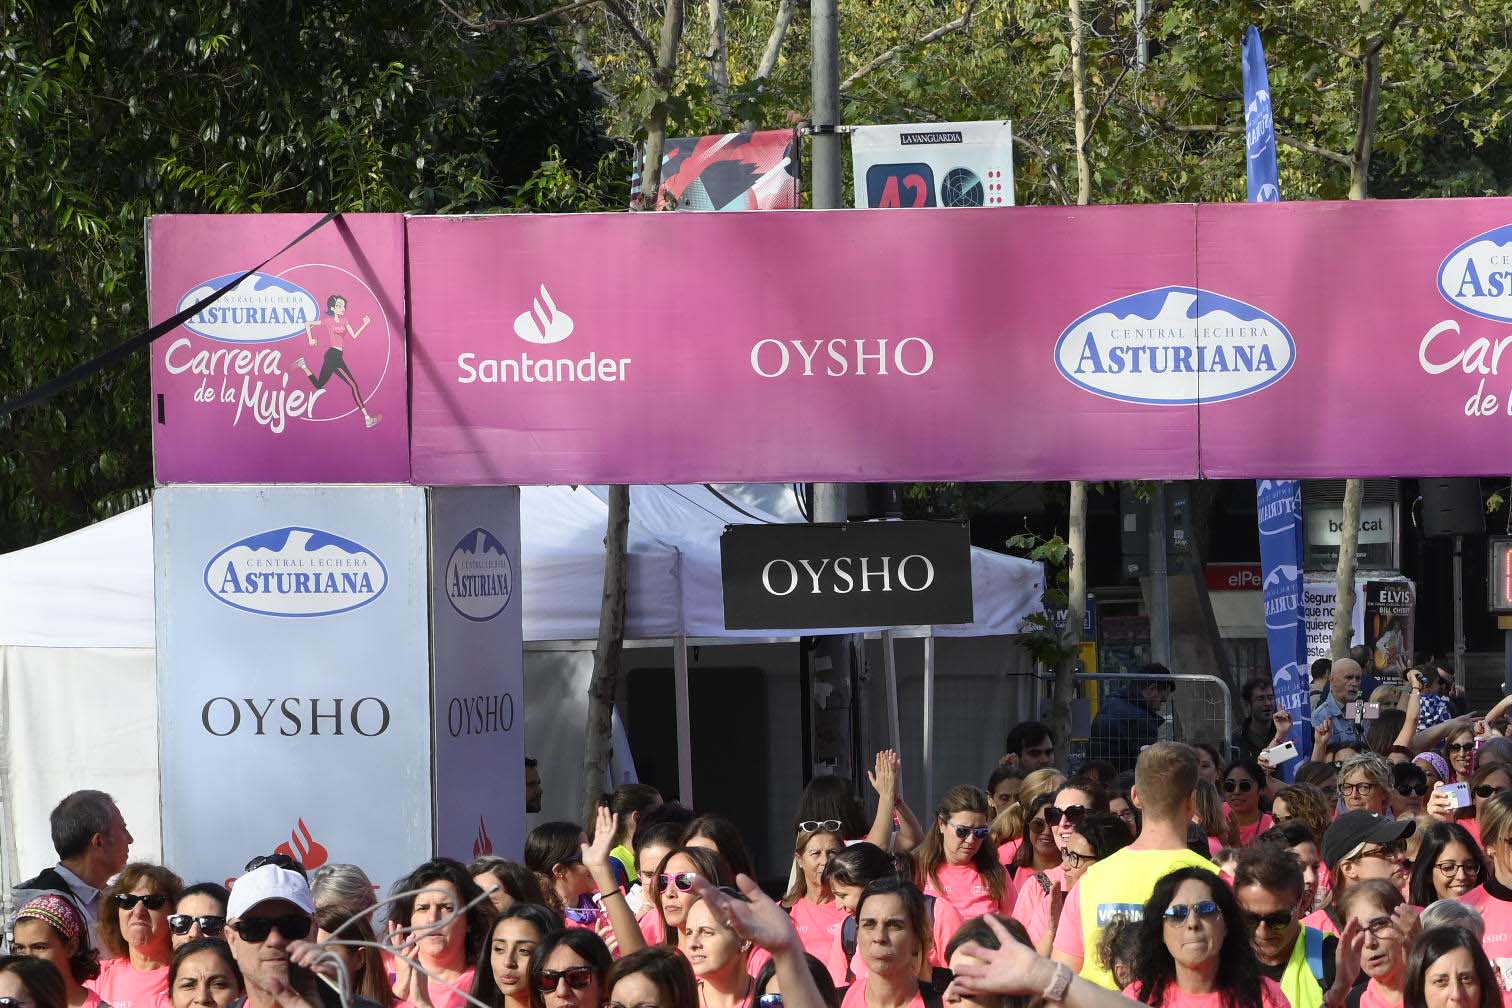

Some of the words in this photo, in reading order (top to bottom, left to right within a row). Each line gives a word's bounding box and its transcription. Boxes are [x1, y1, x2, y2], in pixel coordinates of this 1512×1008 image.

[1111, 328, 1184, 339] CENTRAL
[1193, 327, 1269, 338] LECHERA
[164, 338, 281, 376] Carrera
[457, 352, 631, 384] Santander
[750, 337, 935, 378] OYSHO
[1073, 331, 1278, 374] ASTURIANA
[194, 374, 215, 402] de
[220, 376, 236, 403] la
[233, 372, 327, 434] Mujer
[1464, 377, 1499, 417] de
[218, 560, 374, 595] ASTURIANA
[246, 559, 305, 568] CENTRAL
[310, 558, 368, 568] LECHERA
[451, 562, 509, 599] ASTURIANA
[761, 554, 935, 595] OYSHO
[1228, 570, 1261, 587] elPe
[1380, 591, 1410, 603] ELVIS
[1306, 619, 1336, 633] quiere
[1307, 647, 1324, 657] este
[201, 697, 391, 737] OYSHO
[448, 692, 514, 738] OYSHO
